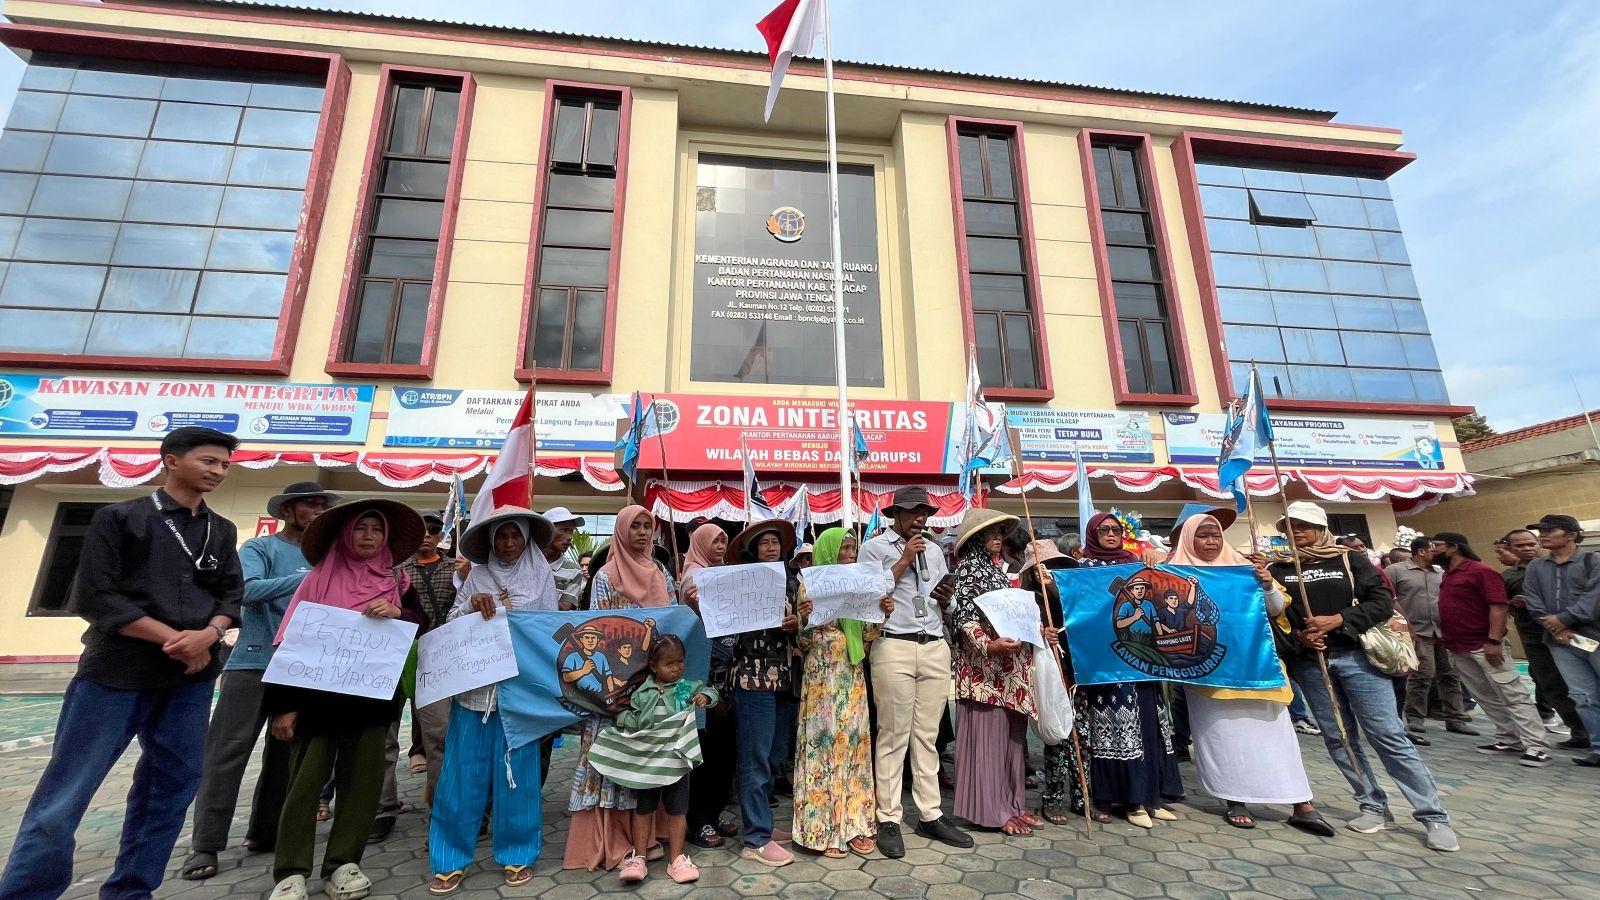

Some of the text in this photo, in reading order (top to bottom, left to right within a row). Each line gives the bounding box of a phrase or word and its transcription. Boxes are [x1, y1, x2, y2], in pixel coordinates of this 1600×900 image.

[695, 254, 758, 266] KEMENTERIAN
[759, 258, 799, 269] AGRARIA
[800, 260, 819, 270] DAN
[820, 261, 837, 270] TAT
[843, 263, 873, 272] RUANG
[718, 266, 750, 277] BADAN
[751, 268, 810, 280] PERTANAHAN
[707, 277, 745, 287] KANTOR
[746, 279, 806, 291] PERTANAHAN
[807, 283, 828, 292] KAB.
[735, 290, 836, 303] PROVINSI JAWA TENGA
[739, 302, 767, 310] Kauman
[768, 303, 788, 311] No.12
[748, 313, 773, 321] 533146
[773, 314, 793, 322] Email
[38, 379, 358, 402] KAWASAN ZONA INTEGRITAS
[420, 392, 453, 401] ATR/BPN
[243, 401, 284, 411] MENUJU
[466, 397, 512, 405] DAFTARKAN
[465, 407, 495, 415] Melalui
[696, 405, 769, 427] ZONA
[540, 418, 572, 427] Langsung
[573, 419, 593, 427] Tanpa
[1057, 430, 1079, 438] TETAP
[774, 449, 820, 461] BEBAS
[699, 569, 774, 598] PETANI
[301, 607, 391, 650] PETANI
[1112, 642, 1225, 678] LAWAN PENGGUSURAN
[288, 660, 397, 689] ORA MANGAN
